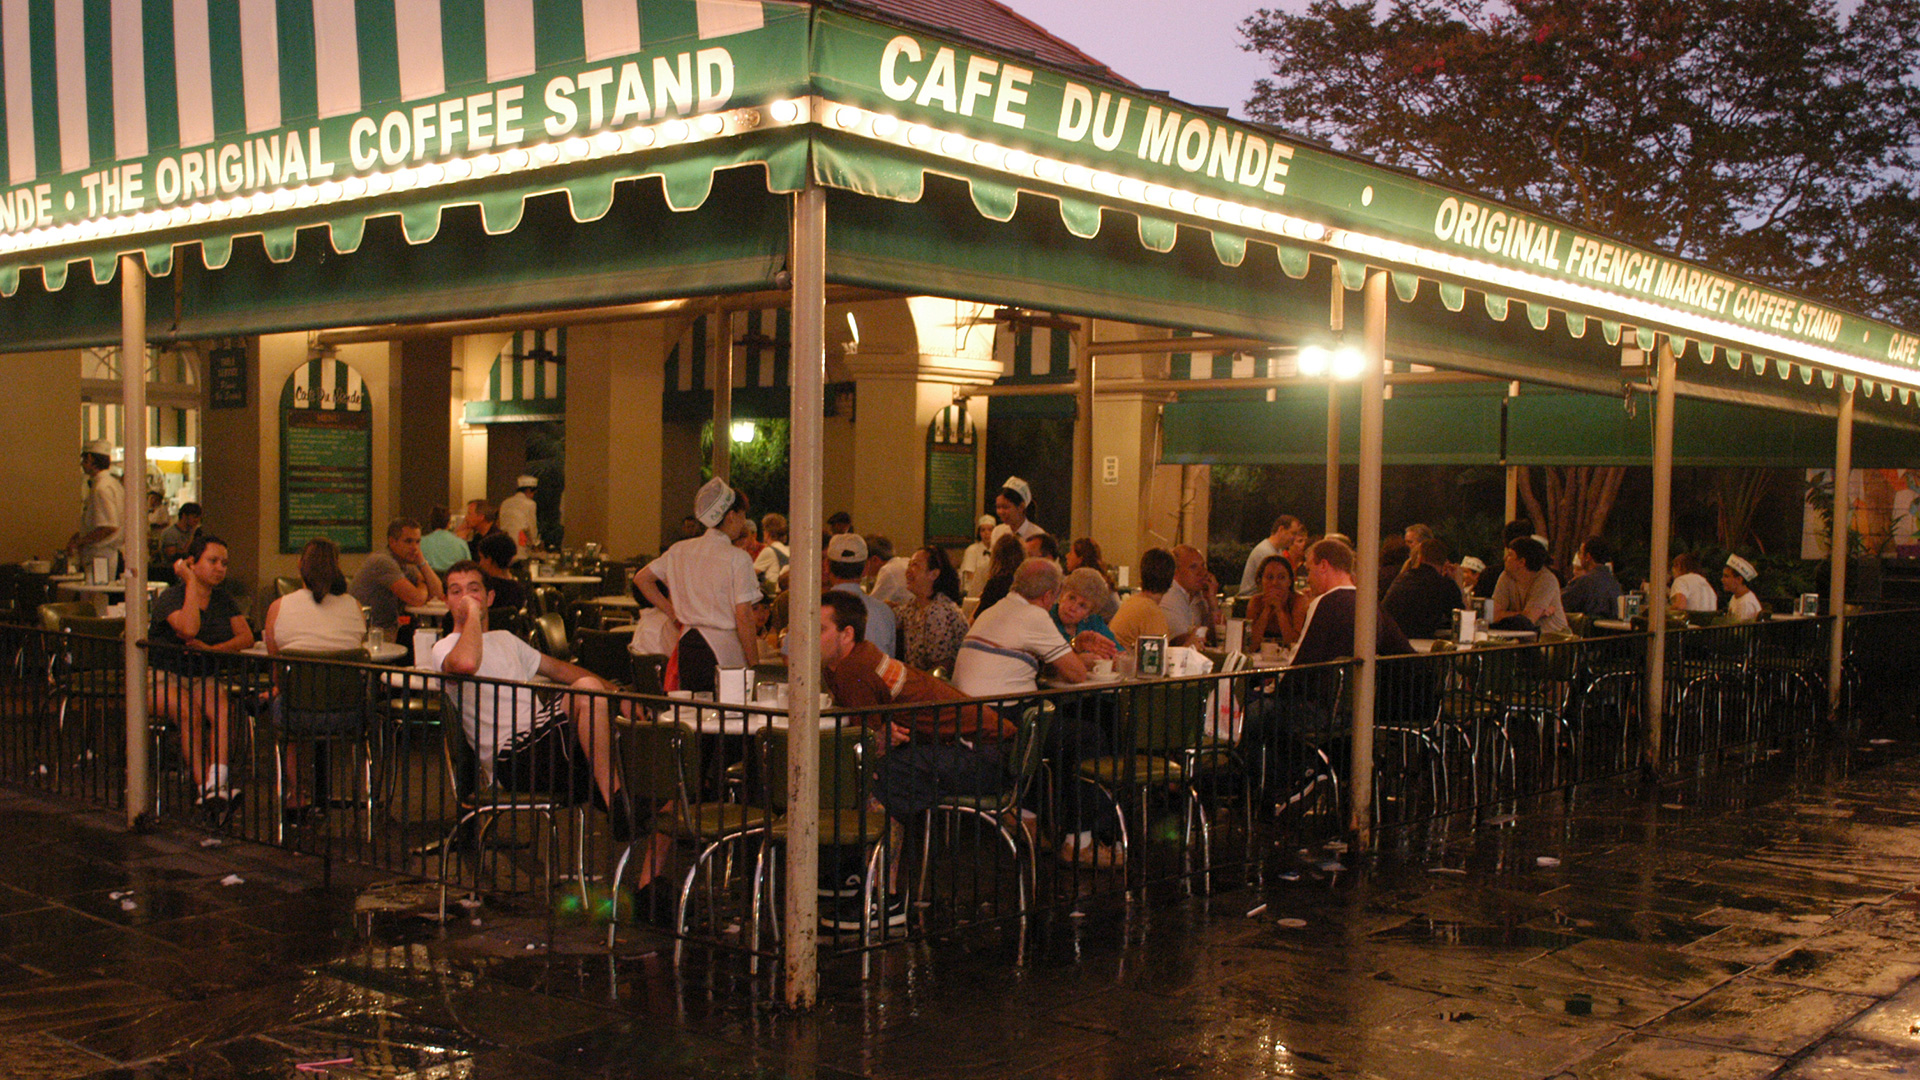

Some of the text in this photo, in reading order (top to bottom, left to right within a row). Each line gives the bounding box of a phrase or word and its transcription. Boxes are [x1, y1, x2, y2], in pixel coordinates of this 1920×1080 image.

[81, 163, 145, 217] THE
[155, 126, 335, 206] ORIGINAL
[349, 85, 524, 170] COFFEE
[544, 47, 735, 136] STAND
[879, 35, 1294, 196] CAFE DU MONDE
[1434, 197, 1842, 342] ORIGINAL FRENCH MARKET COFFEE STAND
[1888, 333, 1919, 364] CAFE
